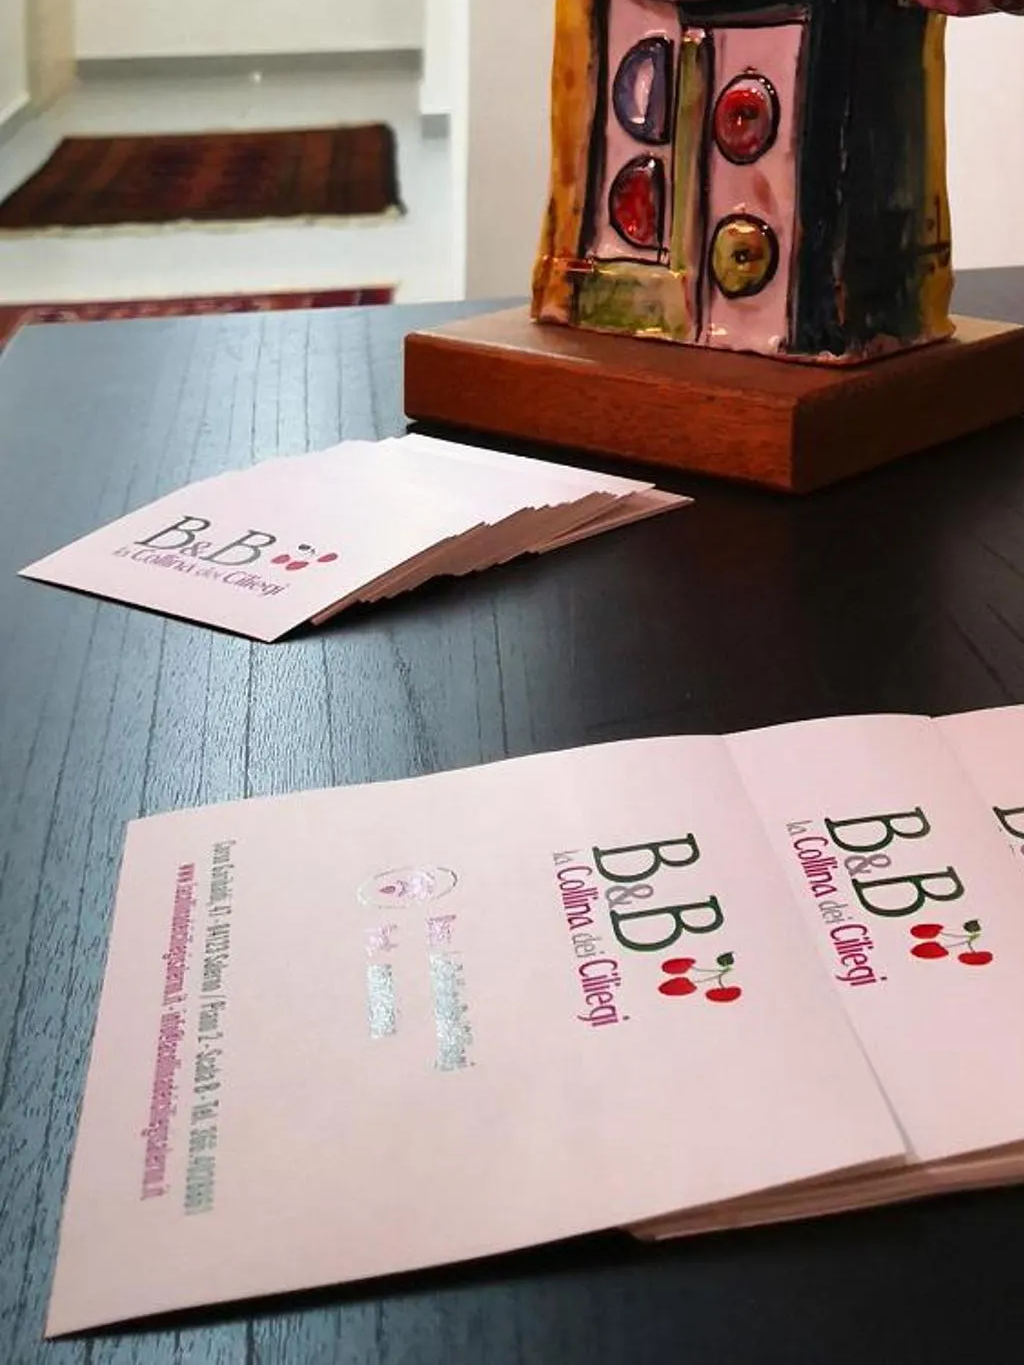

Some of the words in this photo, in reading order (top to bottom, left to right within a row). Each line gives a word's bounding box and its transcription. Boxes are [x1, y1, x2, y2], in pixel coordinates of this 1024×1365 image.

[131, 548, 194, 573] Collina
[134, 516, 277, 567] B&B
[592, 832, 724, 952] B&B
[793, 835, 839, 899] Collina
[824, 806, 966, 918] B&B
[556, 864, 599, 931] Collina
[818, 899, 848, 924] dei
[571, 932, 605, 959] dei
[829, 923, 889, 988] Ciliegi
[577, 958, 630, 1027] Ciliegi
